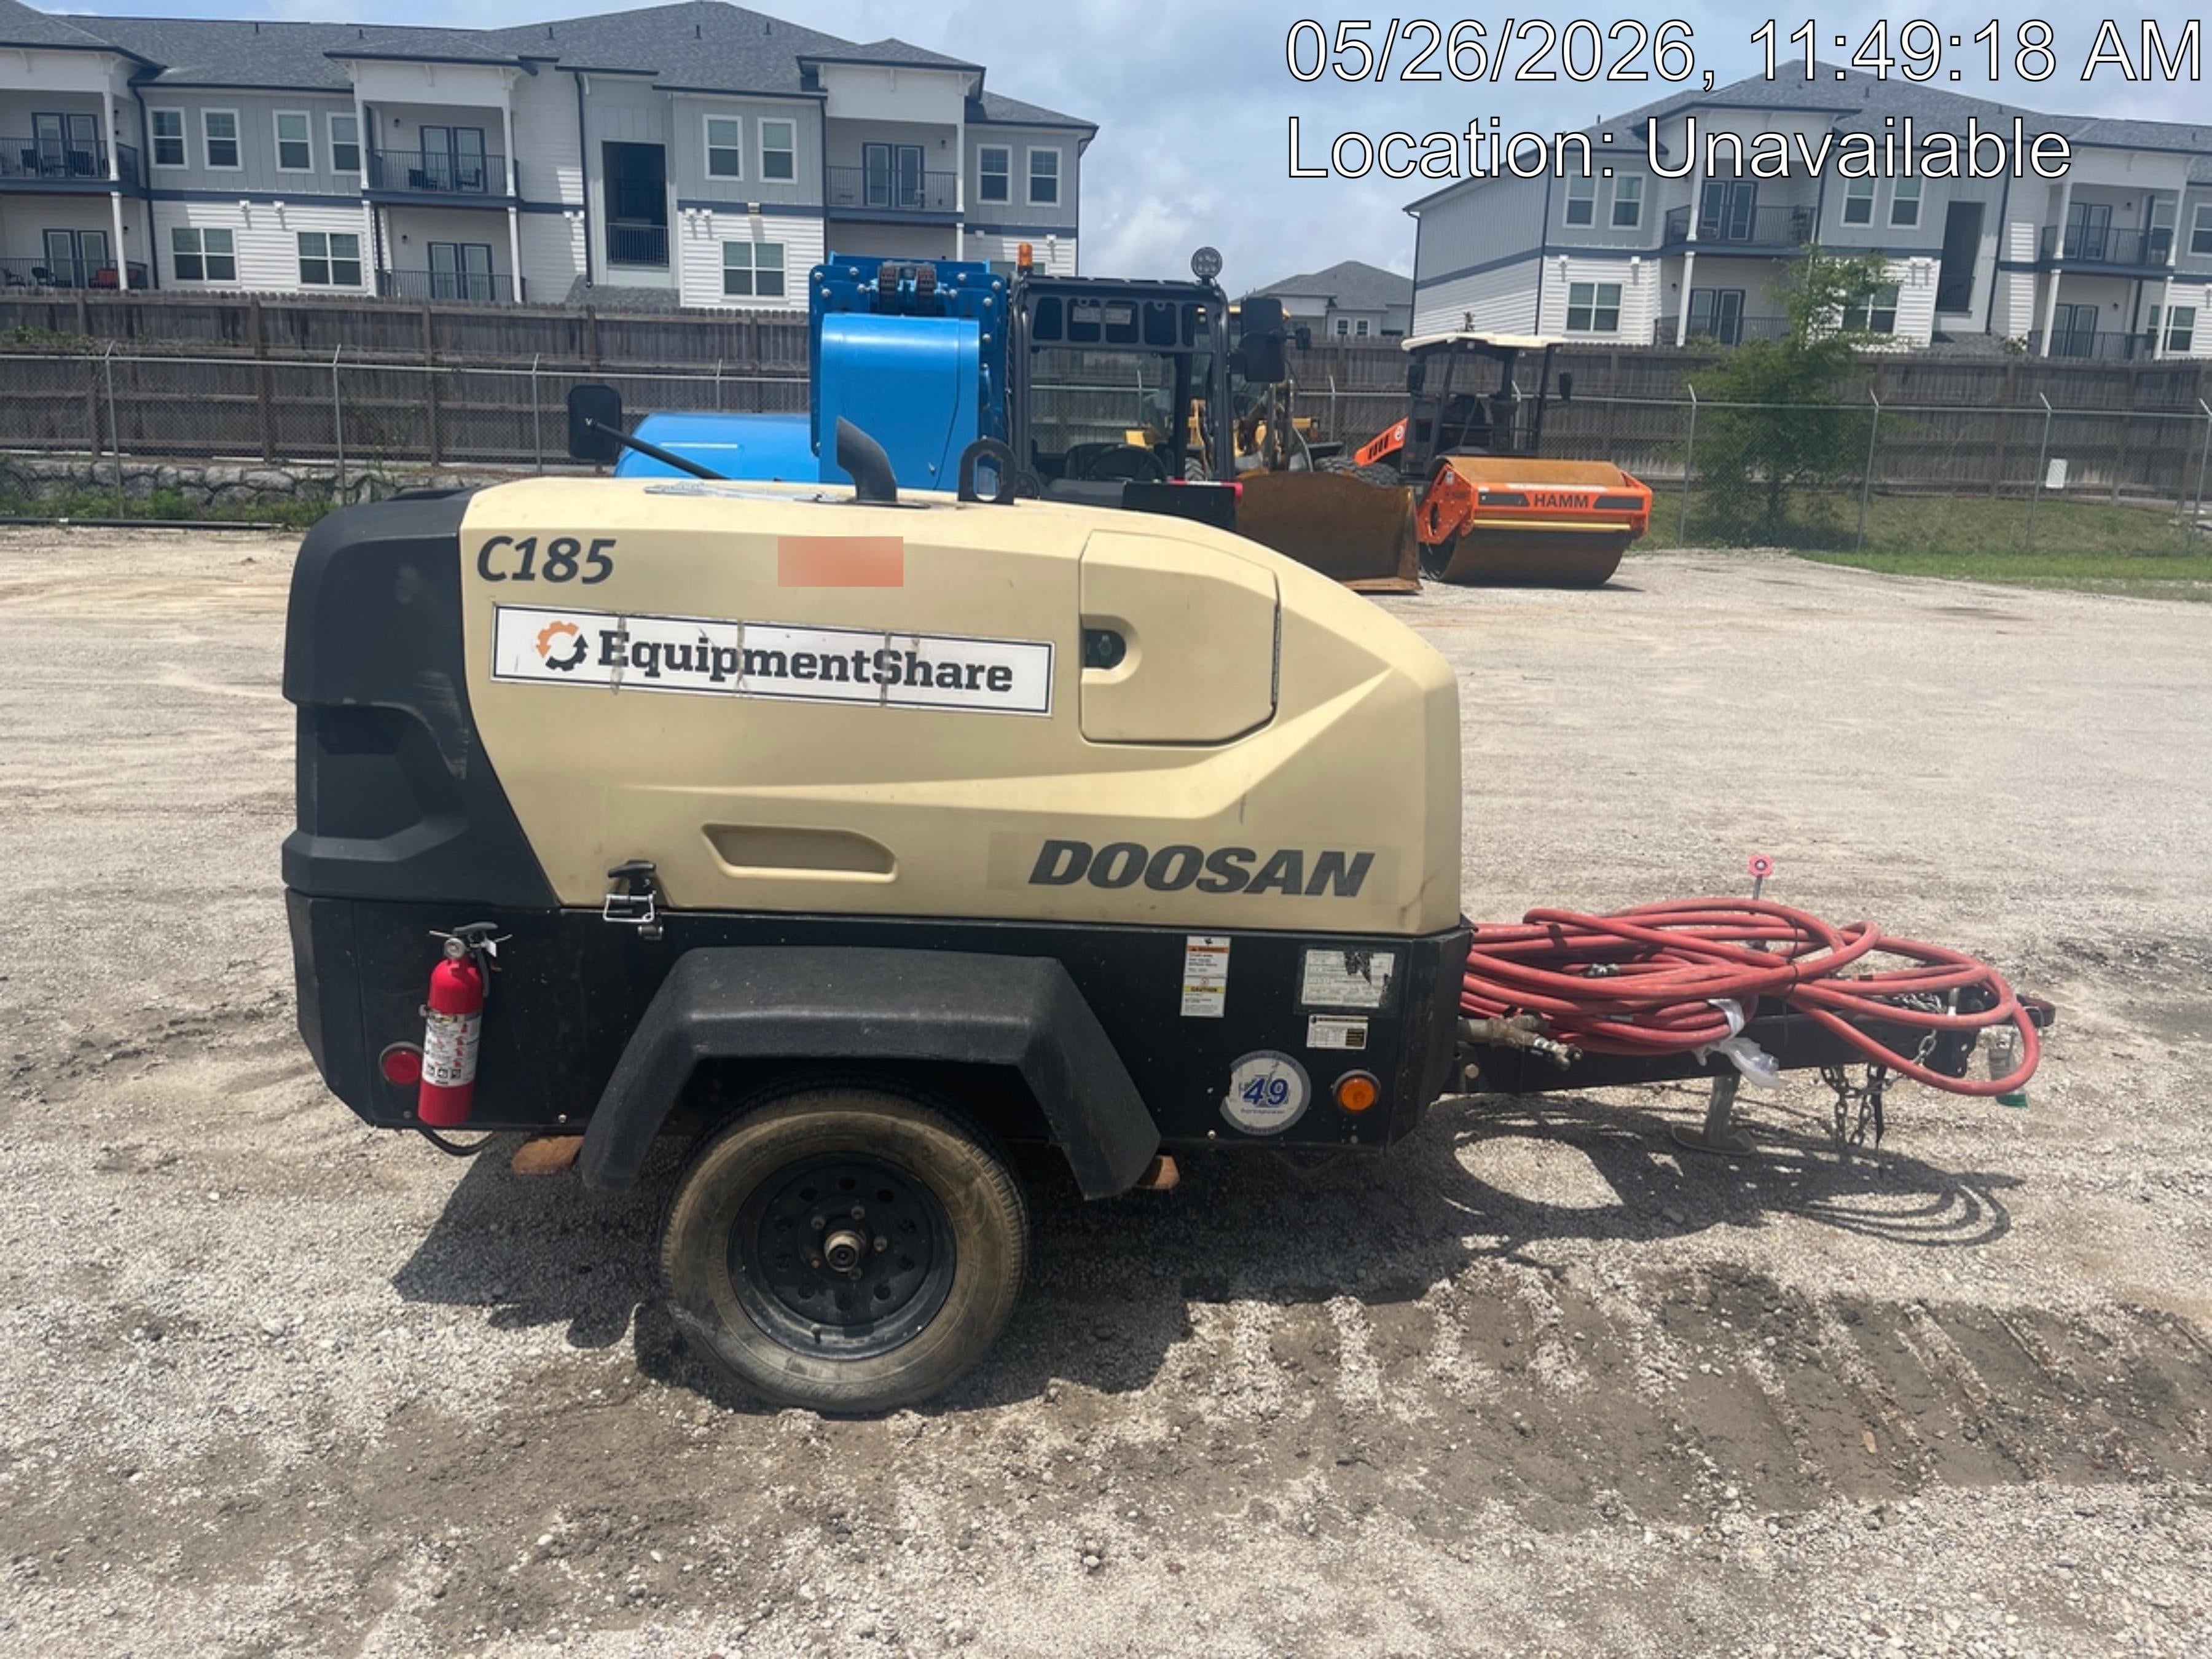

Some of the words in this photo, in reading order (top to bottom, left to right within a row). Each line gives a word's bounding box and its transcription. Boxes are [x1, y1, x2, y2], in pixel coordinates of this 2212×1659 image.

[1533, 493, 1589, 509] HAMM
[477, 536, 616, 584] C185
[598, 630, 1013, 692] EquipmentShare
[1028, 839, 1375, 897] DOOSAN
[1242, 1077, 1289, 1105] 49
